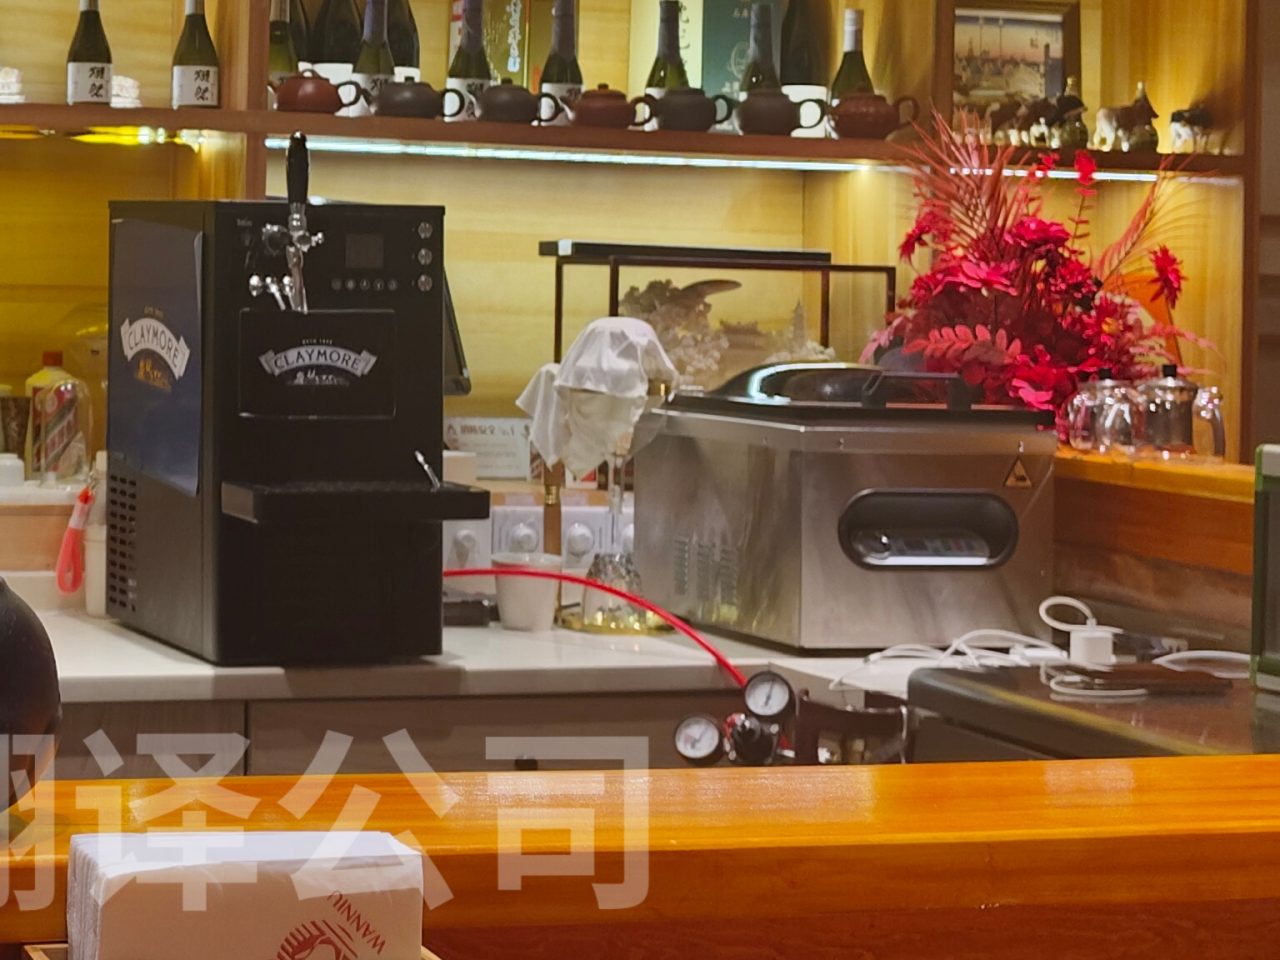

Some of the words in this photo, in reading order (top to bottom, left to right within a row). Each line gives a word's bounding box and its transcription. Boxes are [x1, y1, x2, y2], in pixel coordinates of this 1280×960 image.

[128, 323, 180, 369] CLAYMORE
[274, 347, 361, 370] CLAYMORE
[326, 890, 386, 955] WANNIU
